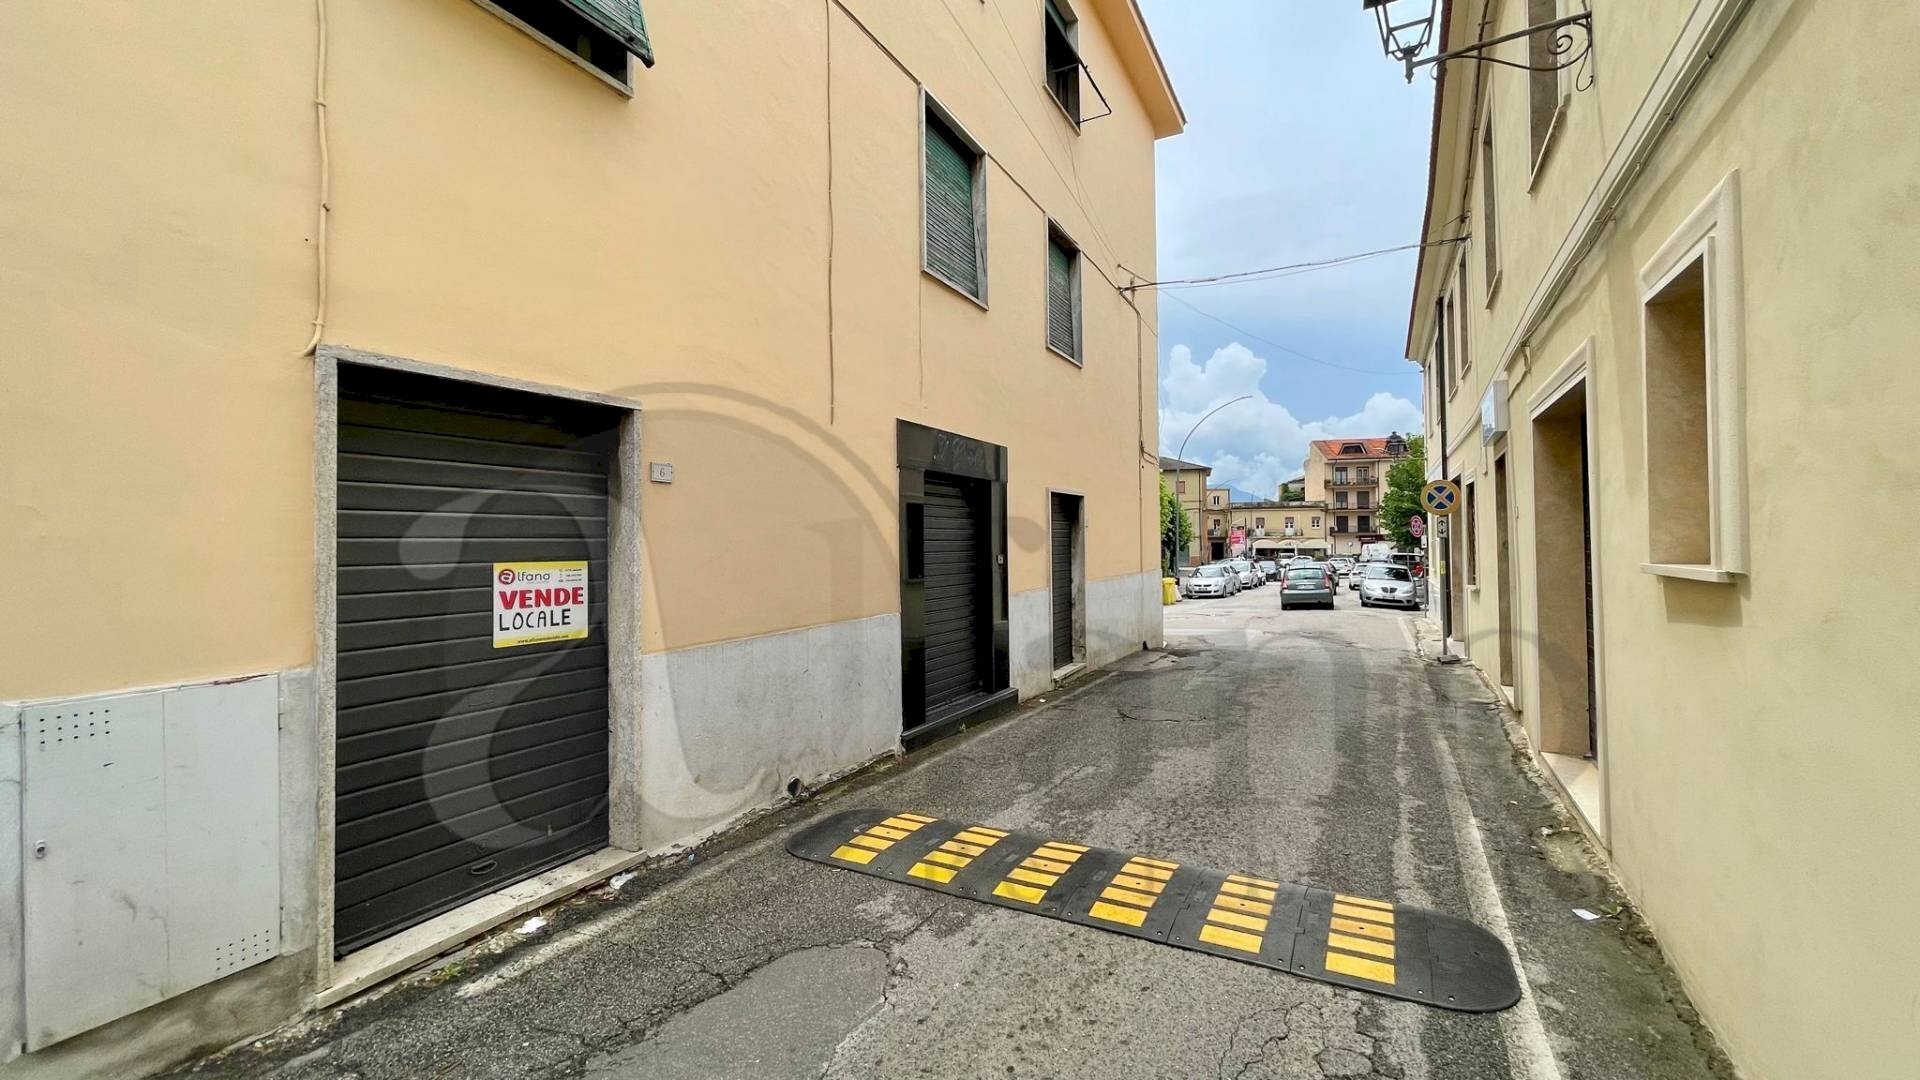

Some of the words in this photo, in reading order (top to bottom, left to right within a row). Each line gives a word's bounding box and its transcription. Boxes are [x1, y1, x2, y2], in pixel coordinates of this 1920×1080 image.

[659, 467, 666, 478] 6
[499, 587, 584, 610] VENDE
[499, 609, 571, 632] LOCALE
